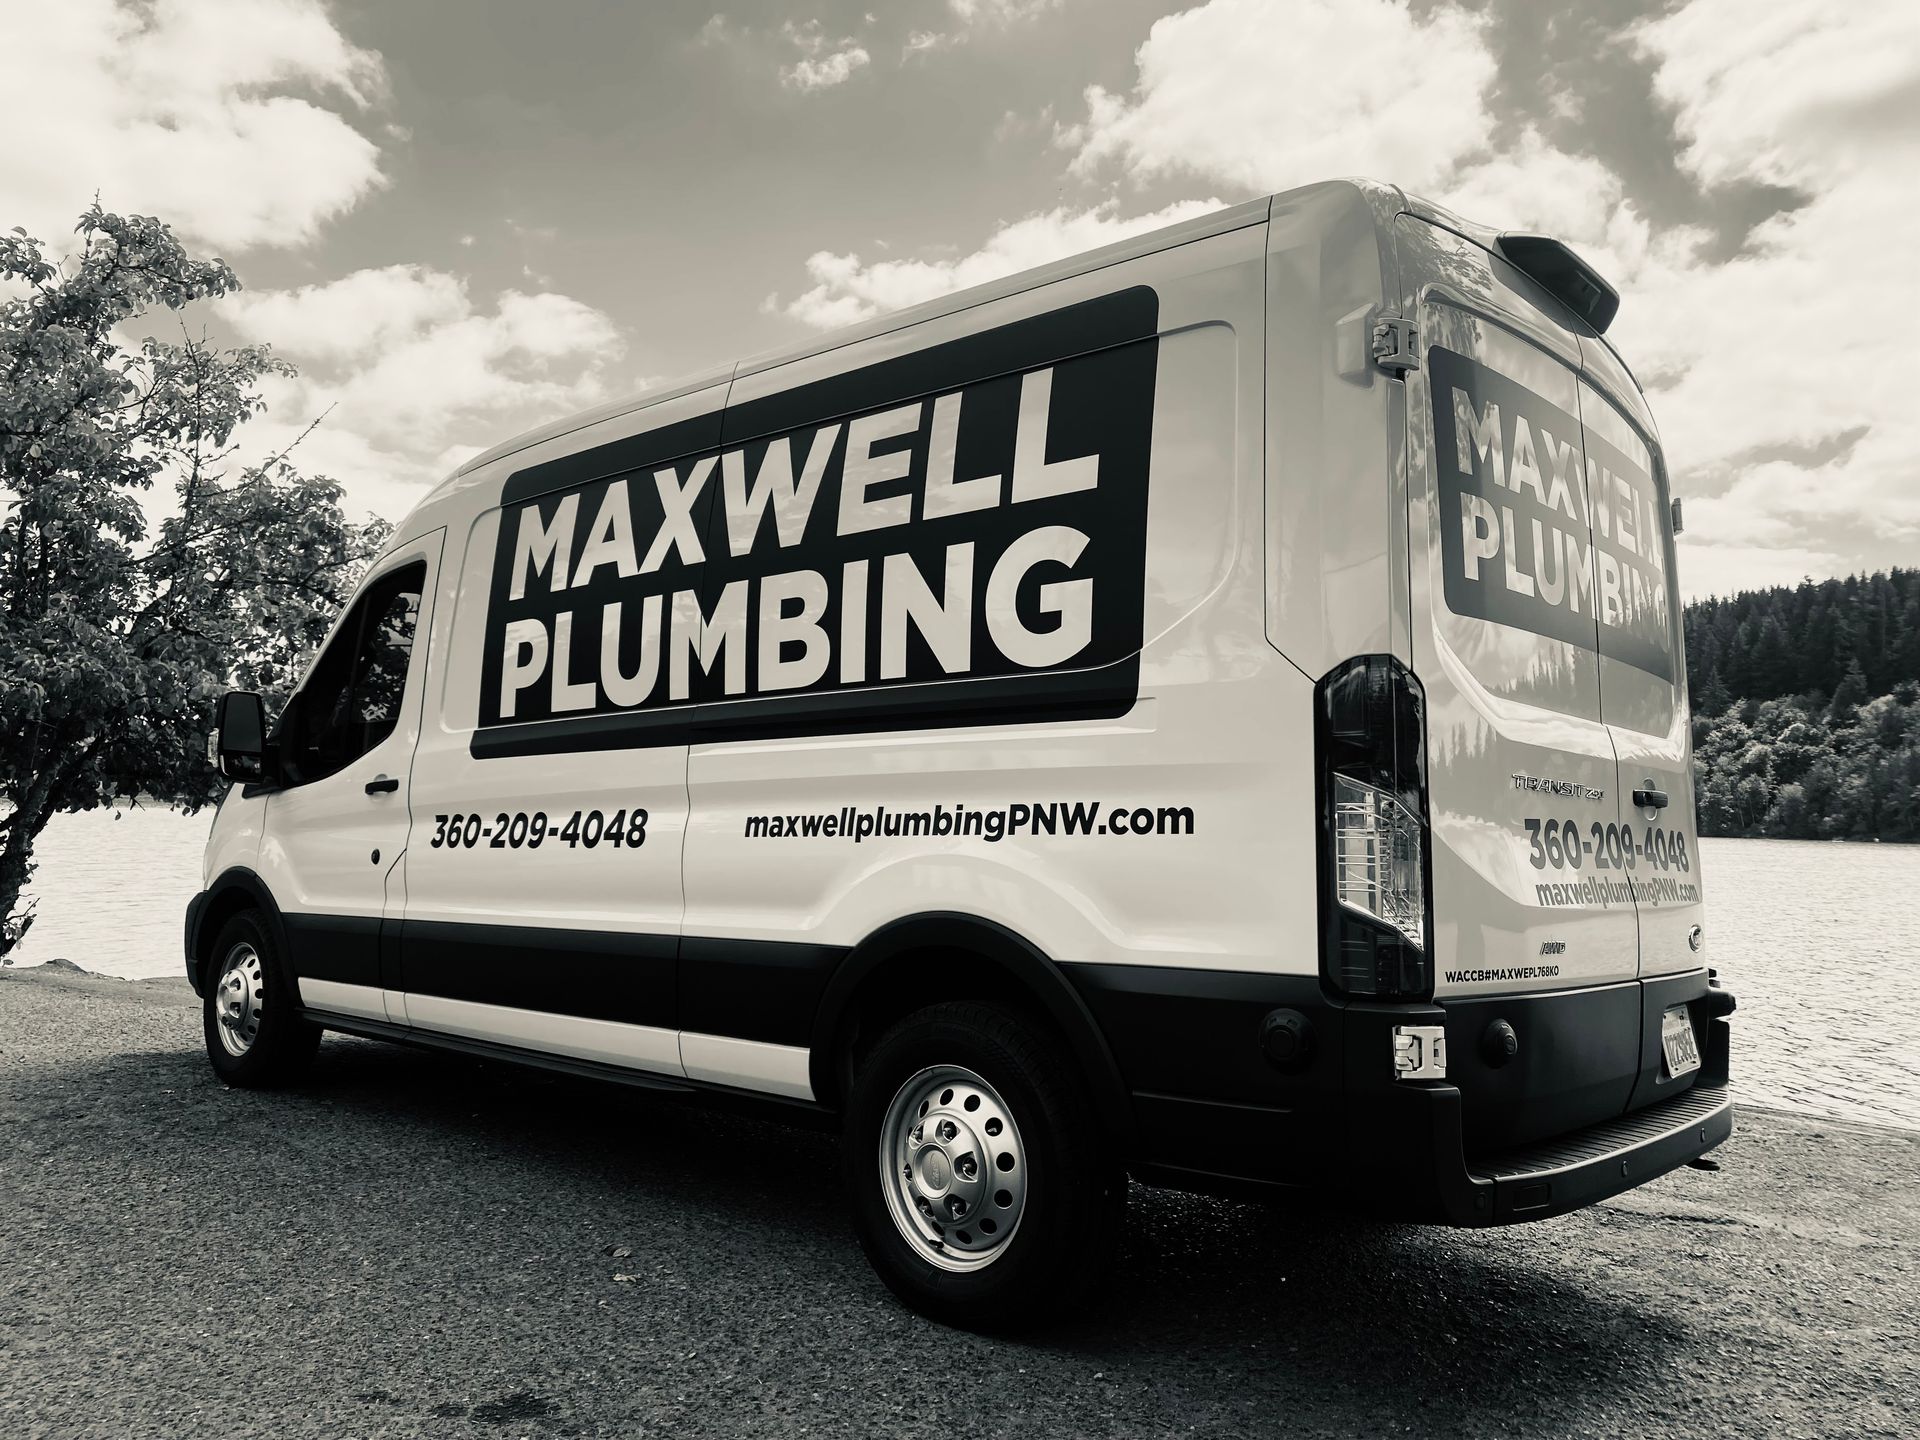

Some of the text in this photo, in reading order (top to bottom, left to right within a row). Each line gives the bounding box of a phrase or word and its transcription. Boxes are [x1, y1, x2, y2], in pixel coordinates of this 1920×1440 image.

[509, 367, 1099, 600] MAXWELL
[500, 525, 1094, 718] PLUMBING
[1512, 774, 1585, 797] TRANSIT
[431, 809, 648, 849] 360-209-4048
[745, 802, 1195, 843] maxwellplumbingPNW.com
[1524, 819, 1690, 873] 360-209-4048
